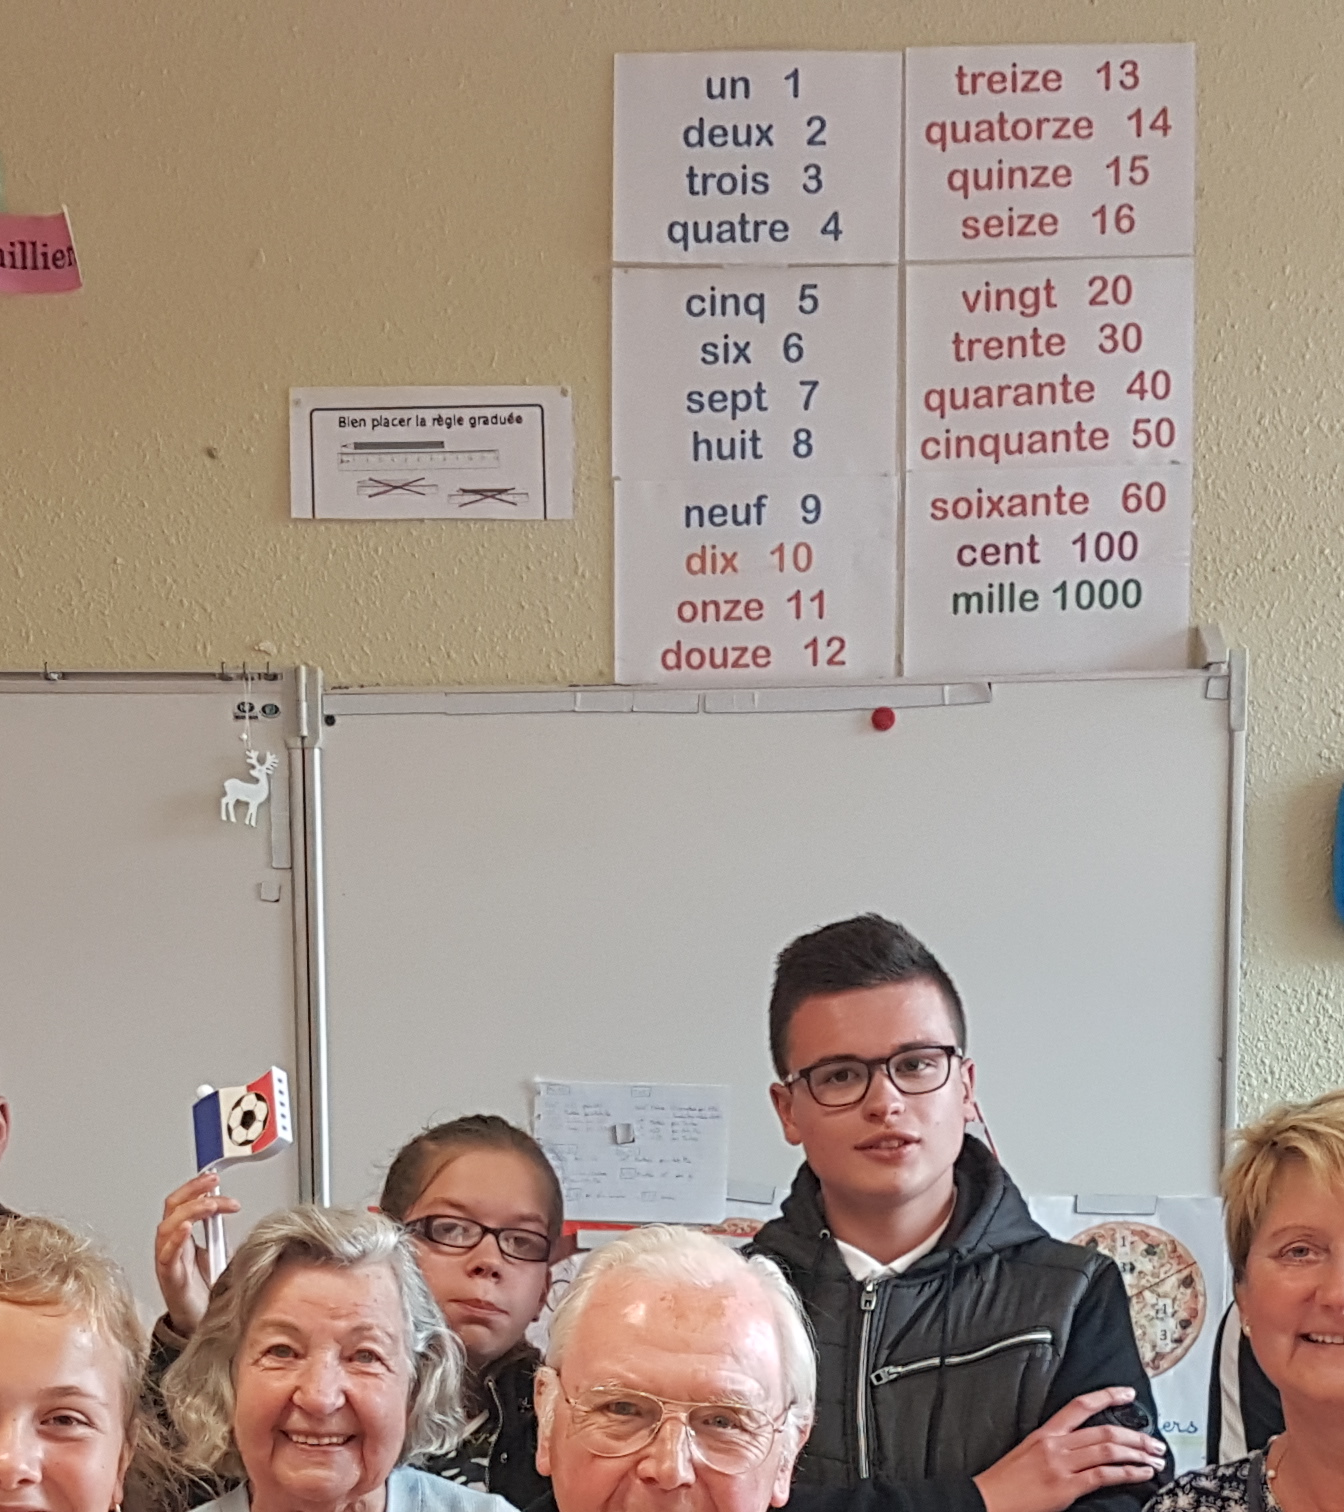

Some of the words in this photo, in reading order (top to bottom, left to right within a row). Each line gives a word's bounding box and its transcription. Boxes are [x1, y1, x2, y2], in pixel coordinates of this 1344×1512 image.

[706, 75, 751, 100] un
[784, 68, 802, 99] 1
[955, 63, 1063, 96] treize
[1095, 60, 1141, 92] 13
[682, 117, 775, 148] deux
[805, 115, 827, 147] 2
[924, 113, 1095, 153] quatorze
[1126, 107, 1173, 139] 14
[686, 165, 770, 196] trois
[802, 163, 824, 194] 3
[946, 159, 1073, 199] quinze
[1104, 155, 1150, 187] 15
[666, 213, 790, 251] quatre
[820, 211, 843, 241] 4
[961, 207, 1060, 240] seize
[1091, 204, 1136, 236] 16
[685, 286, 766, 323] cinq
[797, 284, 820, 315] 5
[961, 278, 1057, 318] vingt
[1087, 274, 1133, 307] 20
[700, 334, 752, 365] six
[782, 332, 805, 363] 6
[952, 328, 1067, 363] trente
[1097, 323, 1143, 354] 30
[686, 382, 768, 419] sept
[798, 380, 820, 411] 7
[923, 375, 1096, 419] quarante
[1126, 370, 1172, 402] 40
[338, 415, 367, 429] Bien
[371, 413, 412, 431] placer
[415, 413, 427, 428] la
[431, 412, 465, 430] règle
[468, 411, 524, 429] graduée
[692, 429, 763, 461] huit
[792, 428, 814, 459] 8
[920, 419, 1110, 464] cinquante
[1131, 418, 1176, 450] 50
[684, 495, 768, 528] neuf
[800, 494, 822, 525] 9
[929, 484, 1091, 522] soixante
[1121, 481, 1167, 514] 60
[685, 544, 738, 576] dix
[769, 542, 813, 574] 10
[956, 535, 1041, 568] cent
[1071, 530, 1138, 562] 100
[677, 597, 765, 623] onze
[786, 589, 827, 620] 11
[952, 582, 1039, 616] mille
[1052, 578, 1143, 612] 1000
[661, 639, 772, 671] douze
[803, 636, 847, 667] 12
[1162, 1420, 1199, 1434] ers
